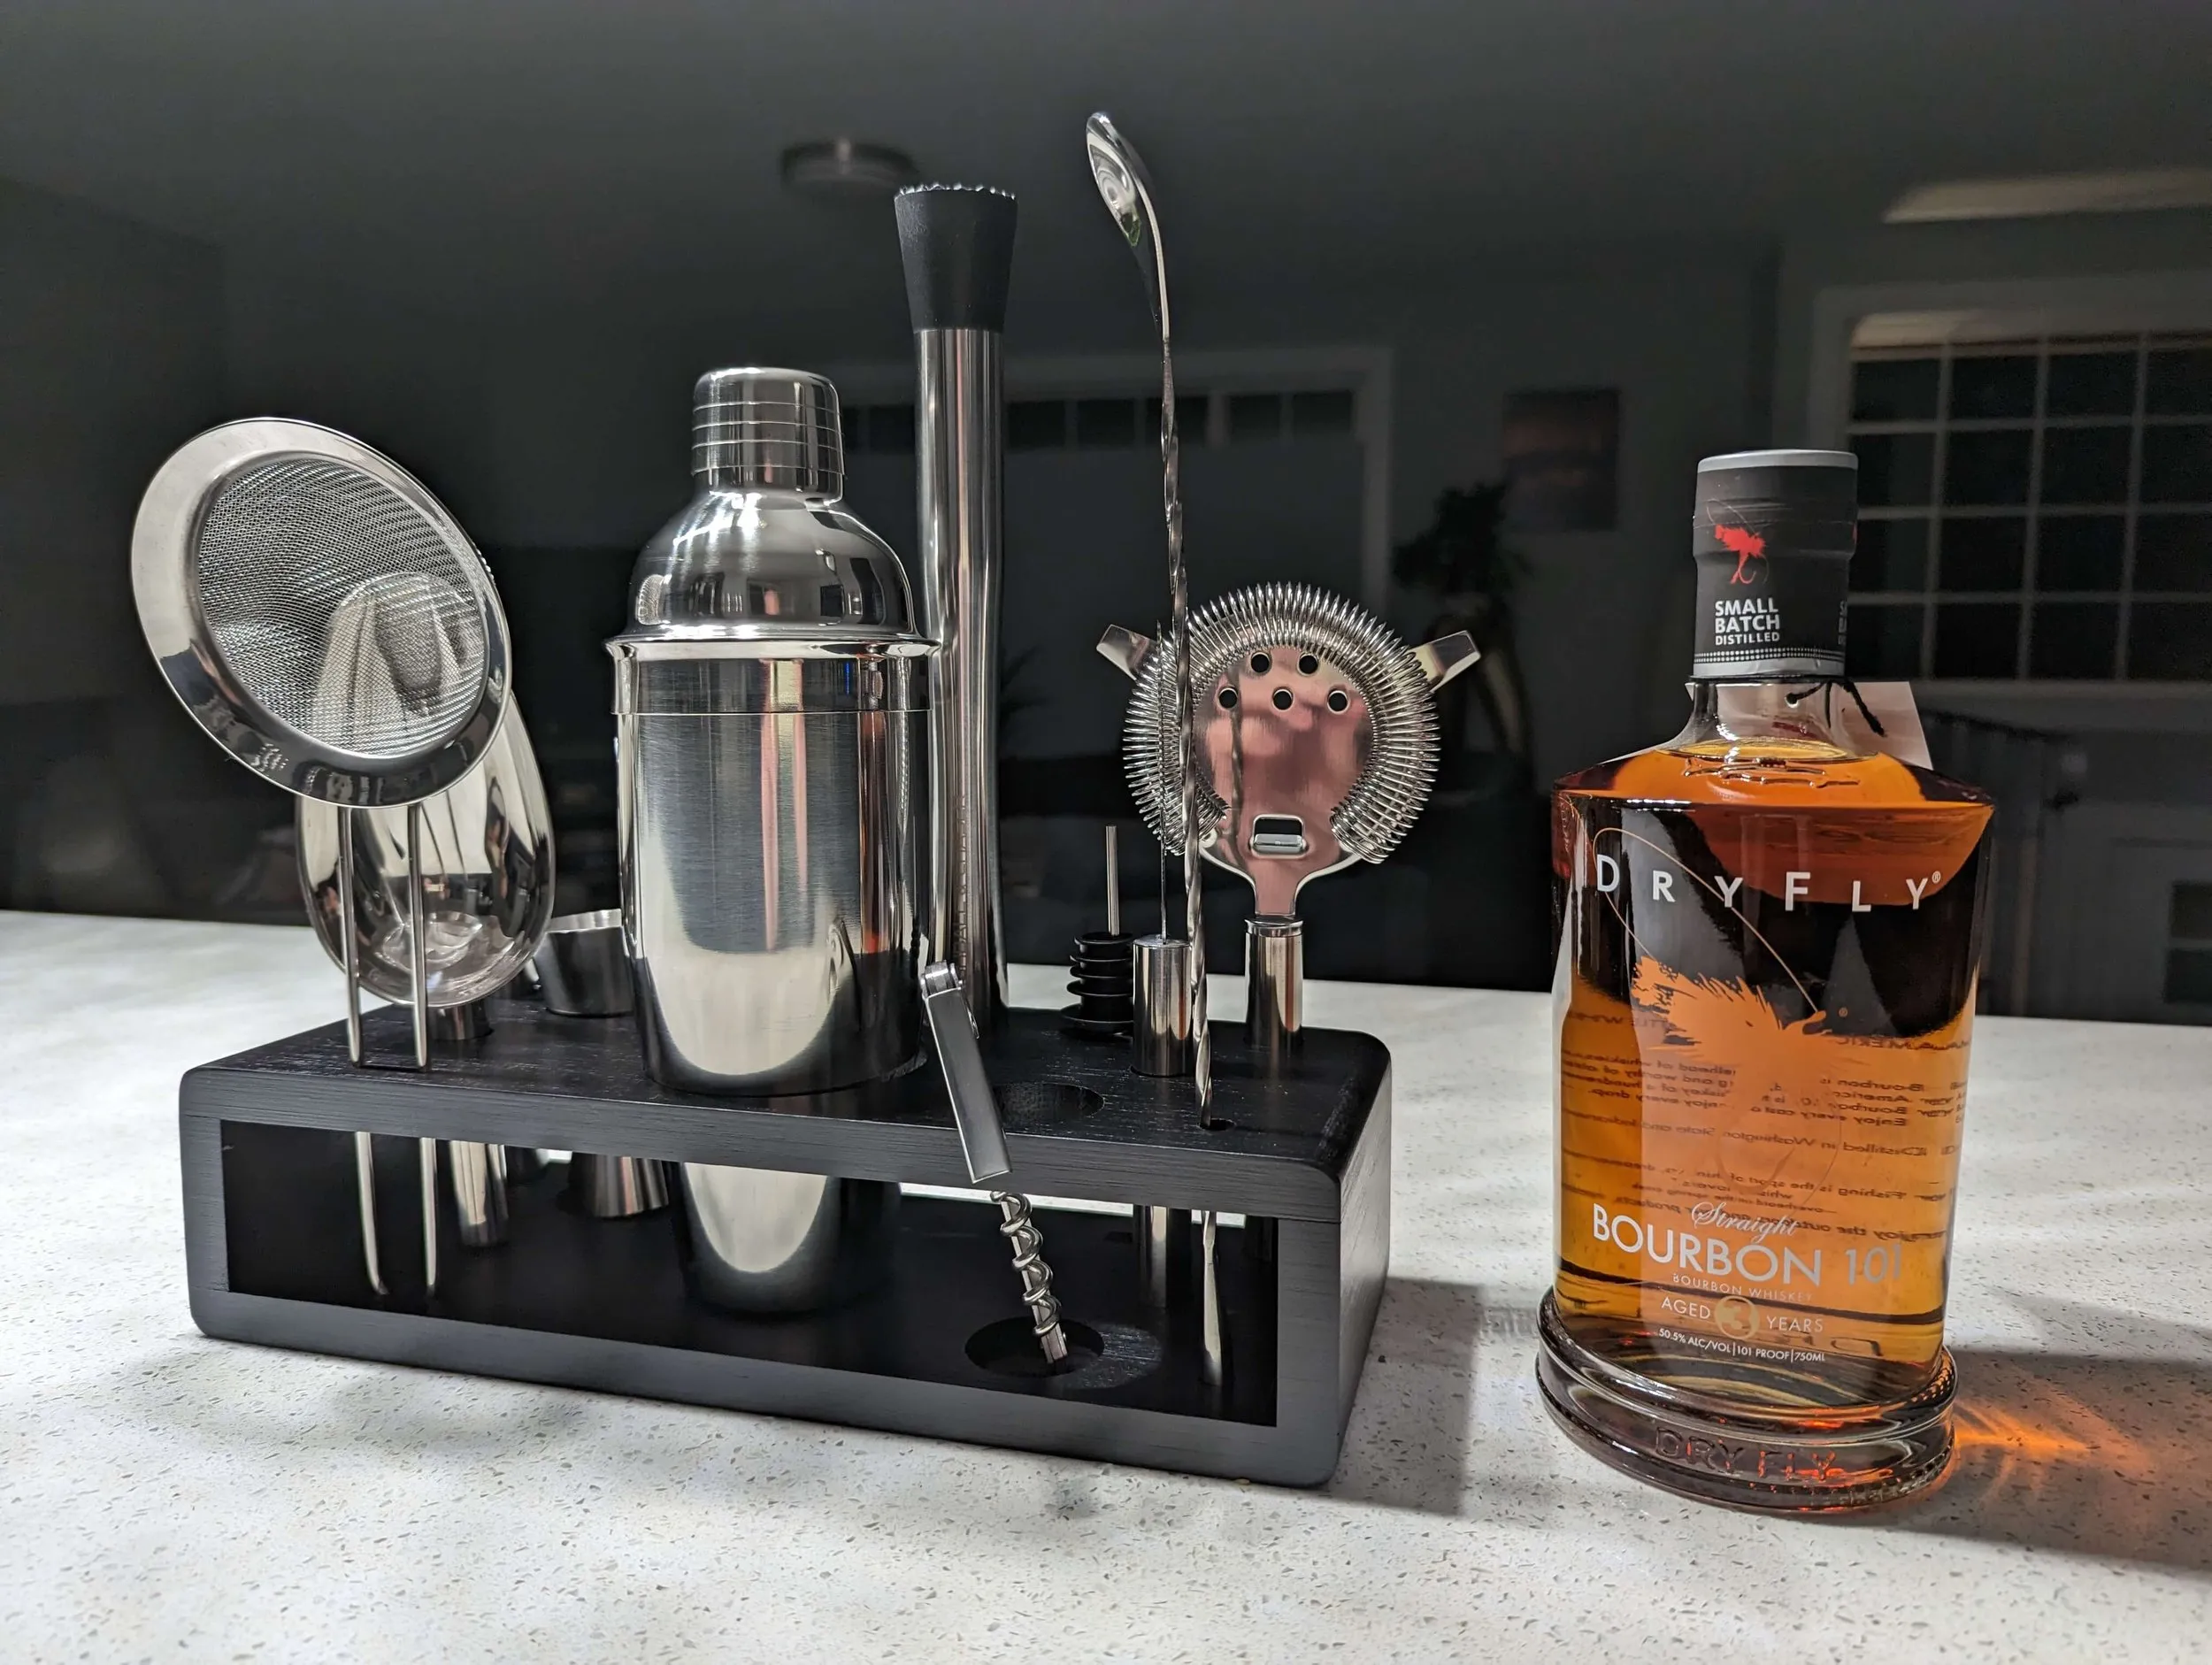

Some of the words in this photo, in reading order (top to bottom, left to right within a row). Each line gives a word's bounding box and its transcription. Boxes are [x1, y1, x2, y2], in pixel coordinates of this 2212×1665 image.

[1715, 597, 1778, 617] SMALL
[1715, 614, 1780, 633] BATCH
[1715, 632, 1780, 646] DISTILLED
[1691, 1202, 1798, 1244] Straight
[1593, 1203, 1822, 1286] BOURBON
[1845, 1242, 1901, 1284] 101
[1672, 1273, 1742, 1295] BOURBON
[1748, 1289, 1813, 1302] WHISKEY
[1661, 1296, 1711, 1319] AGED
[1766, 1315, 1824, 1333] YEARS
[1659, 1328, 1686, 1343] 50.5%
[1655, 1426, 1743, 1477] DRY
[1758, 1449, 1837, 1482] FLY
